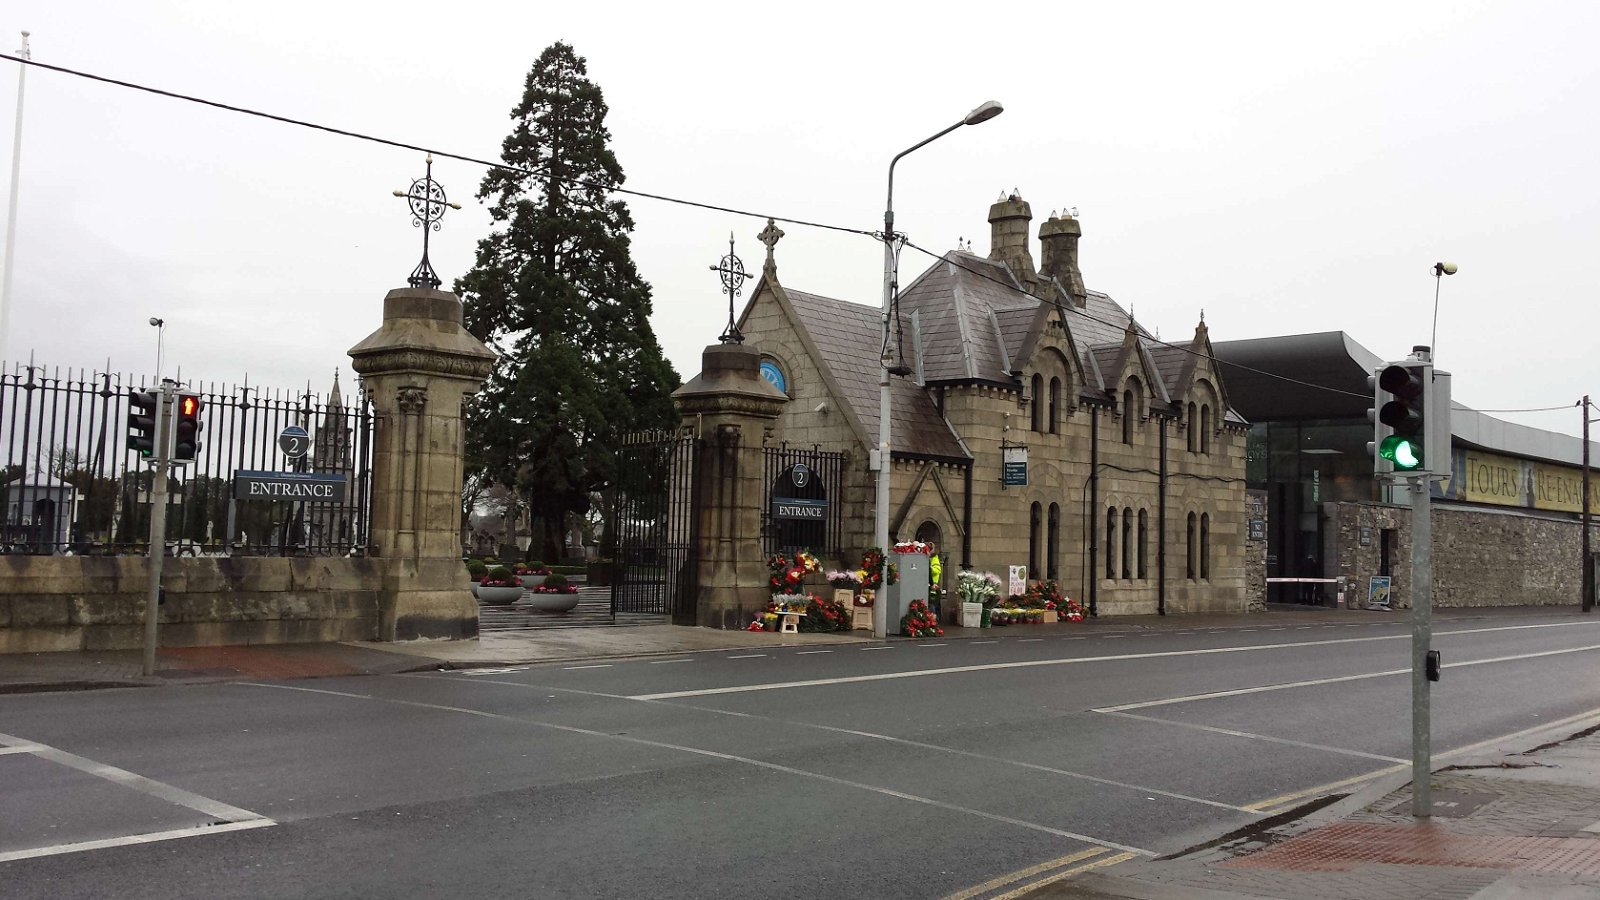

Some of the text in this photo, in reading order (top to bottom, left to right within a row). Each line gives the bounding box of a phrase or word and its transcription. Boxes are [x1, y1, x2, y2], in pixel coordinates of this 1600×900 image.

[289, 437, 299, 453] 2
[797, 472, 804, 484] 2
[1467, 457, 1518, 498] TOURS
[249, 481, 333, 497] ENTRANCE
[779, 506, 822, 517] ENTRANCE
